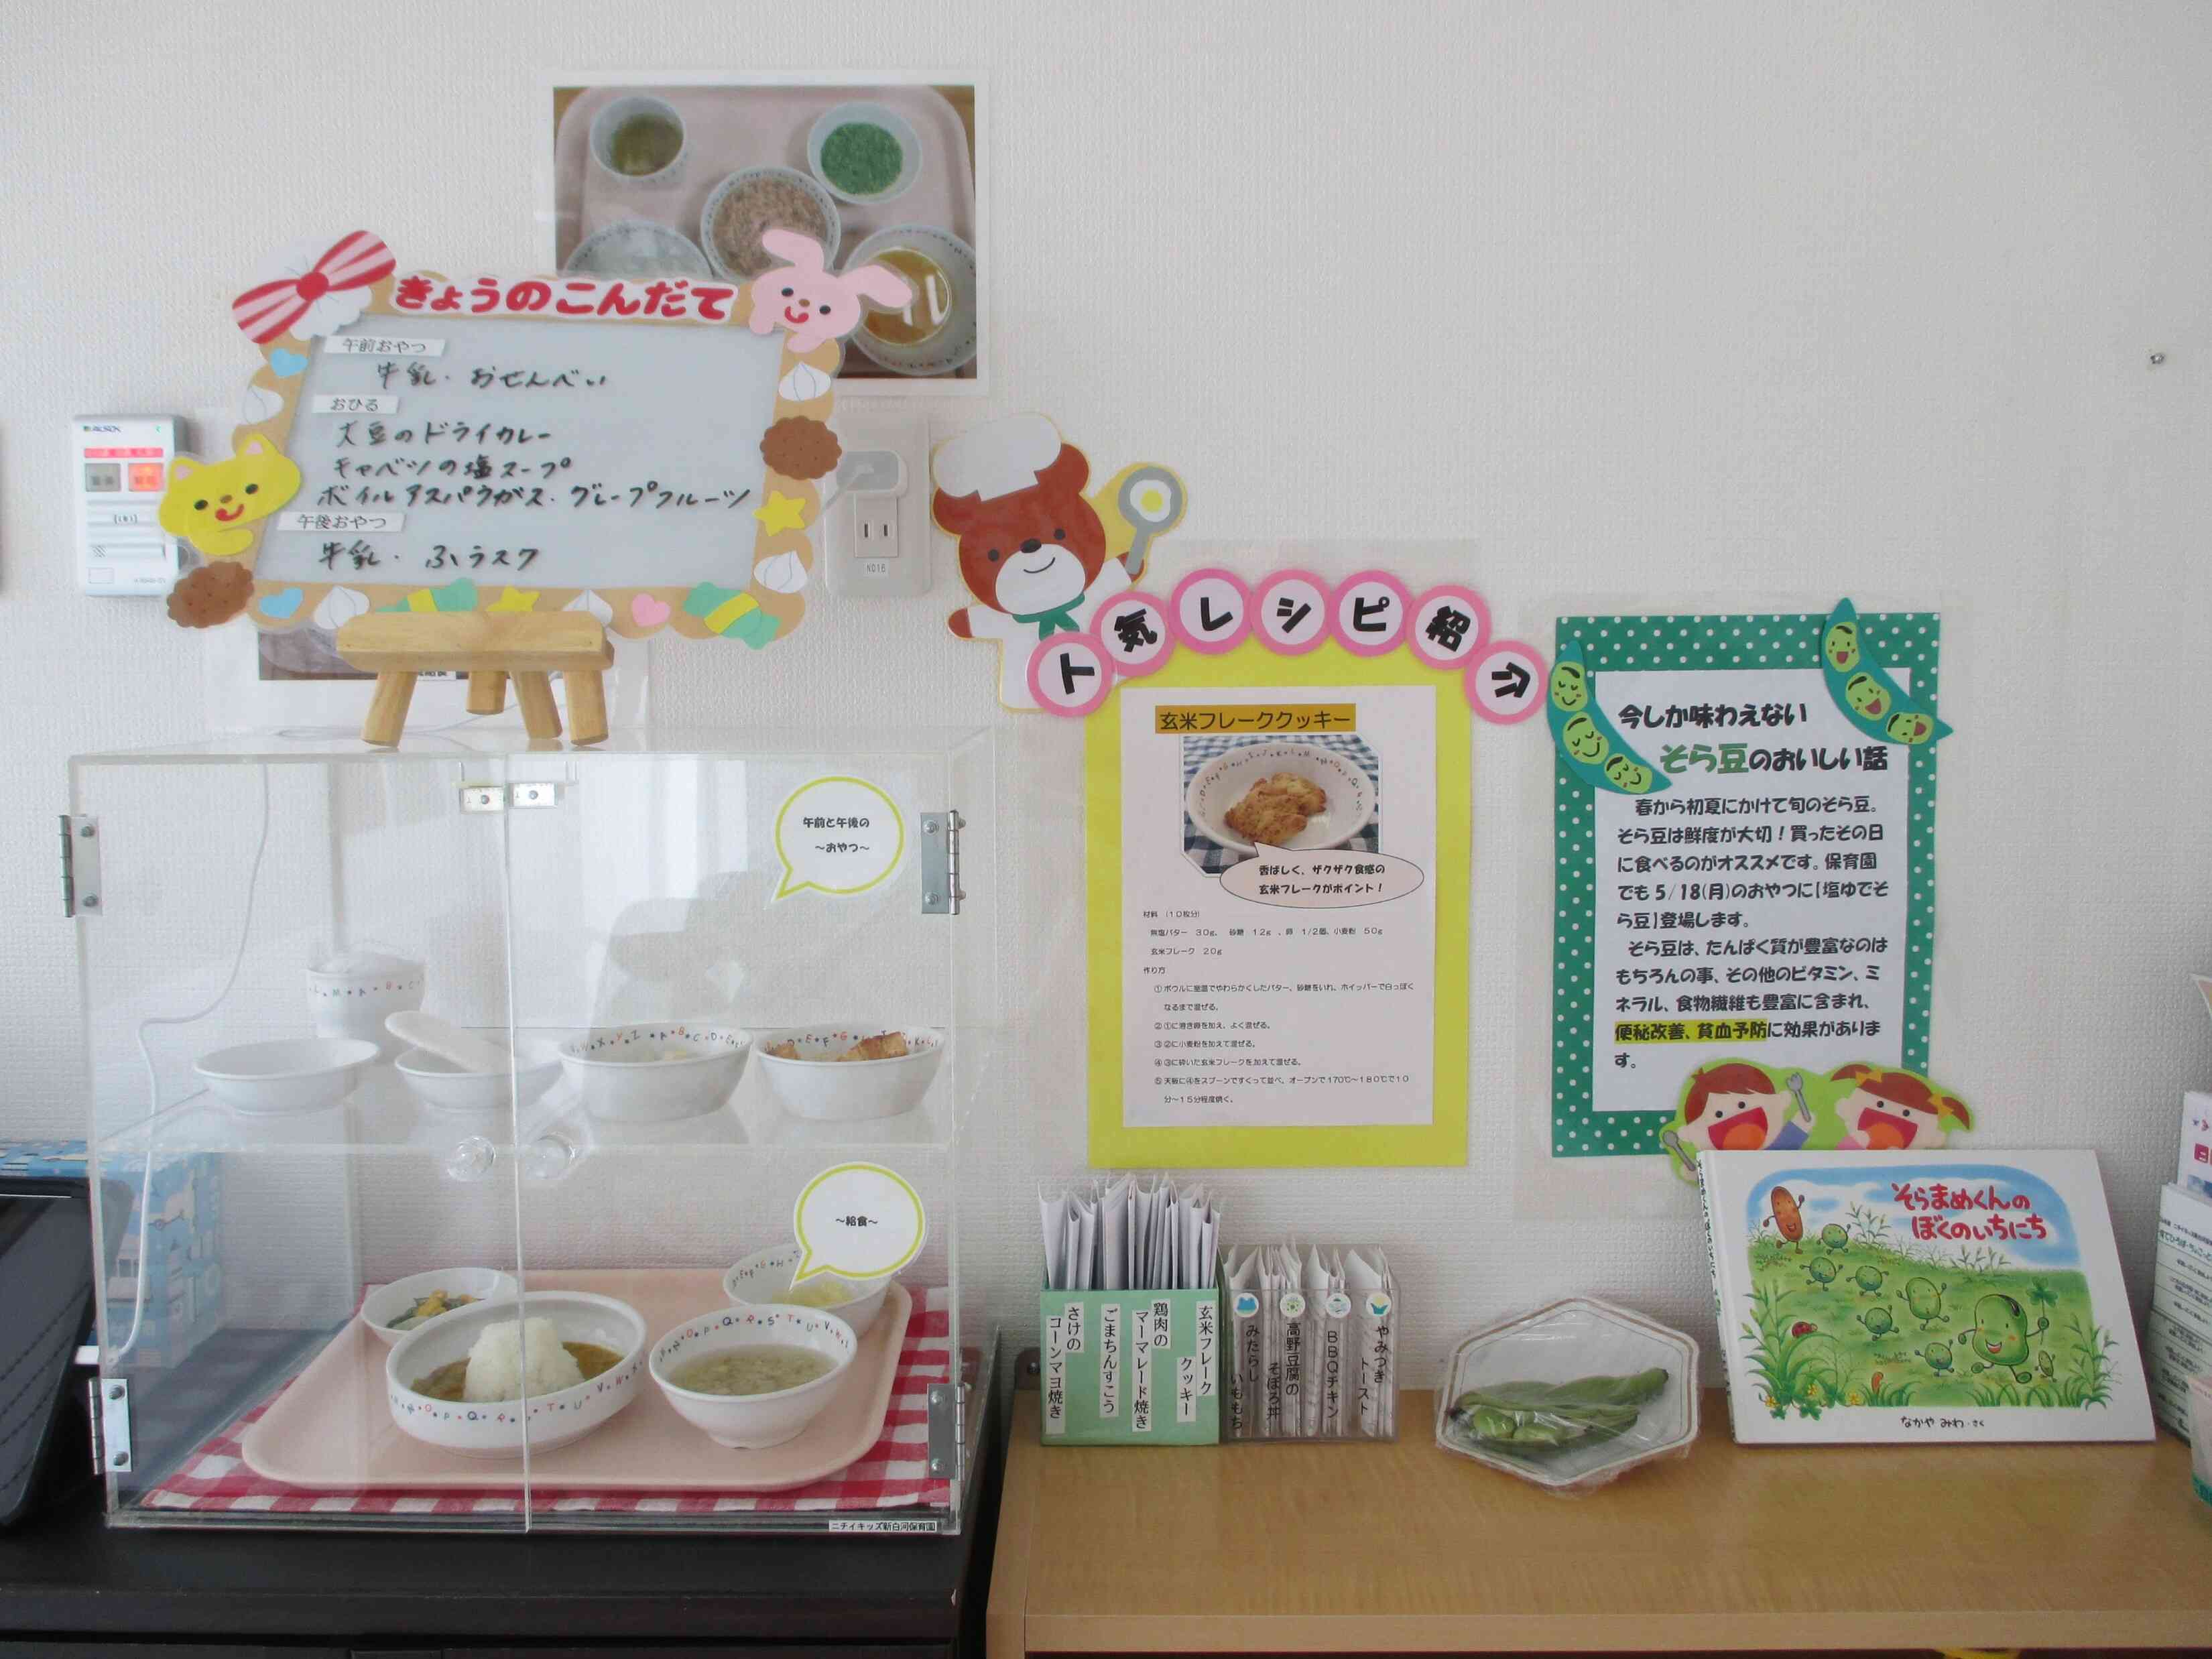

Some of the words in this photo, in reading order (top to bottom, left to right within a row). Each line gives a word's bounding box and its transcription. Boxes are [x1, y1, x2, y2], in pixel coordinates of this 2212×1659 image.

[395, 276, 735, 320] きょうのこんだて
[342, 339, 428, 355] 午前おやつ
[330, 397, 379, 412] おひる
[336, 420, 552, 449] 大豆のドライカレー
[334, 455, 572, 480] キャベツの塩スープ
[298, 513, 387, 530] 午後おやつ
[1160, 711, 1351, 731] 玄米フレーククッキー
[1618, 702, 1807, 729] 今しか味わえない
[1660, 742, 1889, 774] そら豆のおいしい話
[1636, 795, 1878, 816] 春から初夏にかけて旬のそら豆。
[803, 816, 870, 828] 午前と午後の
[1617, 824, 1884, 845] そら豆は鮮度が大切！買ったその日
[1259, 863, 1386, 877] 香ばしく、ザクザク食感の
[1617, 852, 1878, 873] に食べるのがオススメです。保育園
[1259, 882, 1384, 896] 玄米フレークがポイント！
[1150, 928, 1188, 937] 無塩バター
[1150, 948, 1196, 956] 玄米フレーク
[1203, 947, 1223, 957] 20g
[1627, 936, 1888, 957] そら豆は、たんぱく質が豊富なのは
[1143, 966, 1166, 975] 作り方
[1615, 965, 1881, 985] もちろんの事、その他のビタミン、ミ
[1164, 1002, 1219, 1012] なるまで混ぜる。
[1615, 993, 1870, 1013] ネラル、食物繊維も豊富に含まれ、
[1615, 1020, 1882, 1042] 便秘改善、貧血予防に効果がありま
[1614, 1052, 1637, 1069] す。
[1891, 1182, 2031, 1212] そらまめくんの
[1911, 1213, 2047, 1241] ぼくのいちにち
[1066, 1306, 1081, 1351] さけの
[1153, 1302, 1169, 1347] 鶏肉の
[1103, 1308, 1117, 1414] ごまちんすこう
[1198, 1305, 1214, 1396] 玄米フレーク
[1245, 1325, 1260, 1383] みたらし
[1286, 1323, 1301, 1396] 高野豆腐の
[1374, 1325, 1390, 1384] やみつき
[1048, 1317, 1064, 1420] コーンマヨ焼き
[1133, 1310, 1149, 1430] マーマレード焼き
[1327, 1331, 1339, 1419] BBQチキン
[1180, 1356, 1194, 1416] クッキー
[1266, 1362, 1282, 1420] そぼろ丼
[1357, 1357, 1370, 1416] トースト
[1230, 1373, 1244, 1430] いももち
[1900, 1415, 1934, 1428] なかや
[831, 1521, 936, 1532] ニチイキッズ新白河保育園
